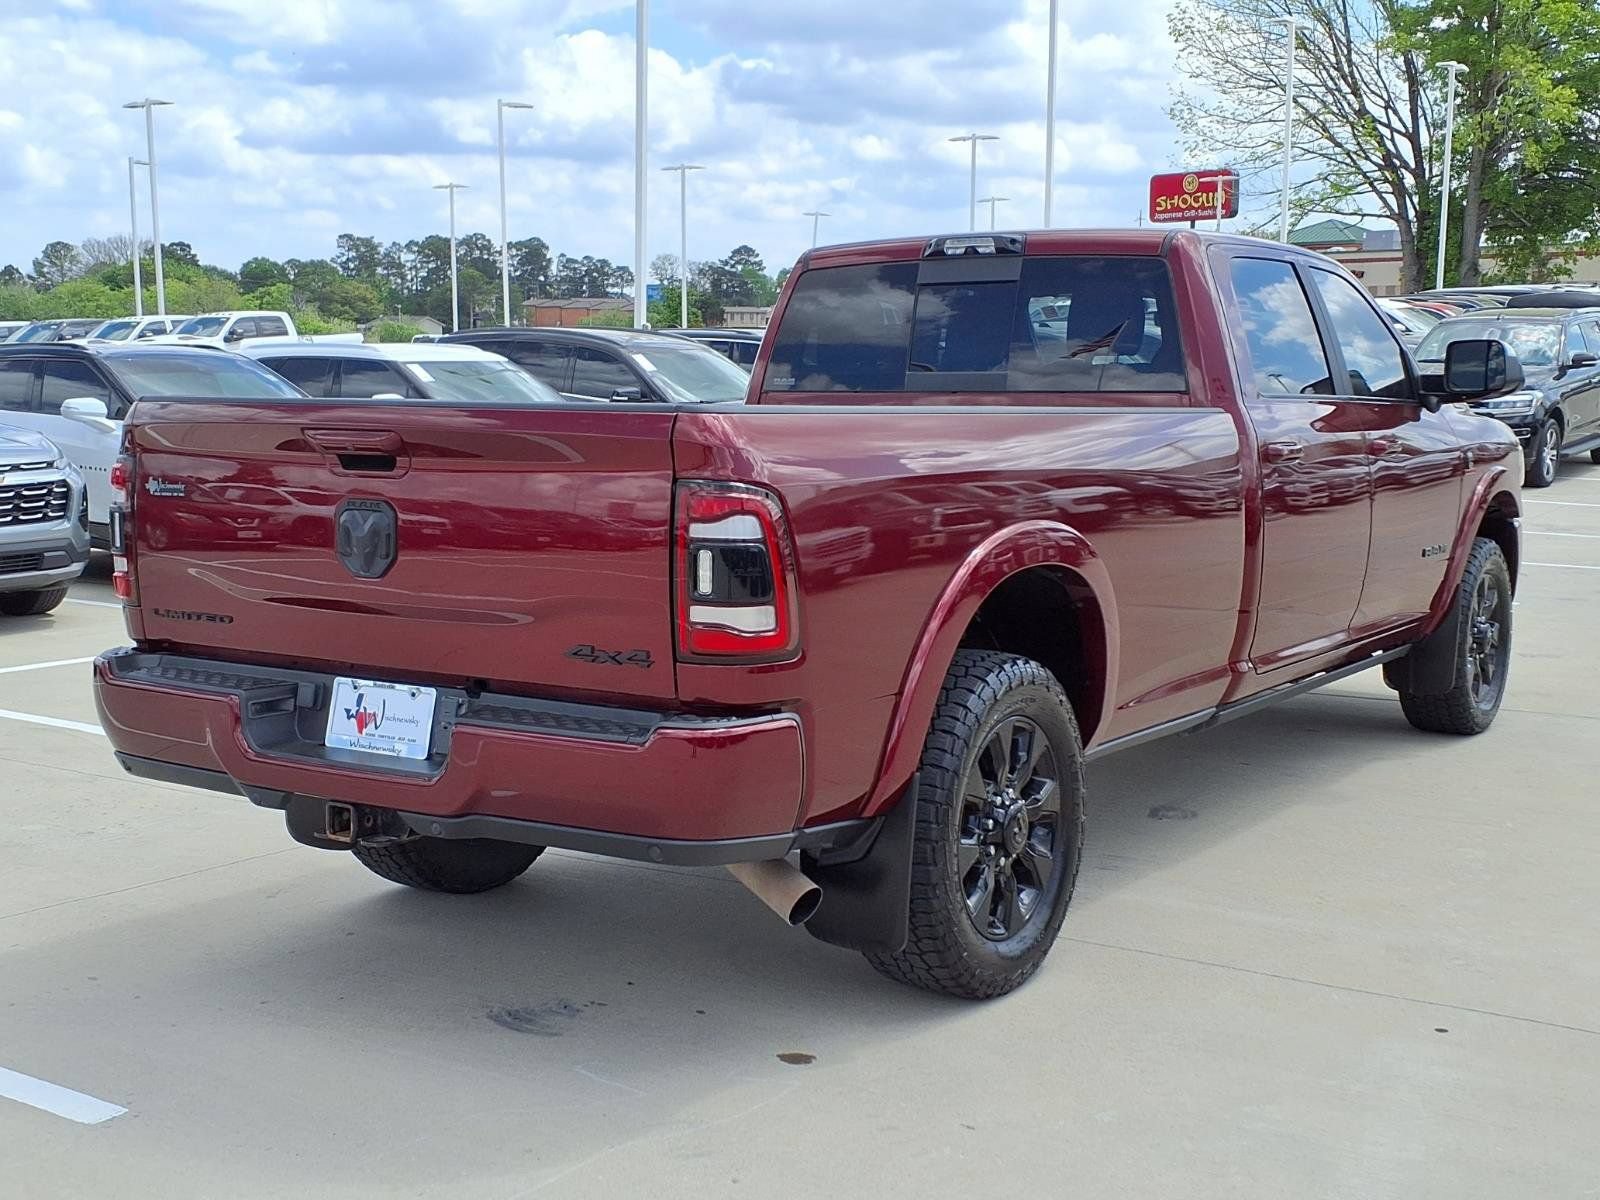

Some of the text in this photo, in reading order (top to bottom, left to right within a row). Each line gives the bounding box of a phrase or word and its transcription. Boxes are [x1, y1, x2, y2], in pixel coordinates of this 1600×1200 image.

[1154, 212, 1183, 221] Japanese
[346, 500, 385, 509] RAM
[152, 607, 235, 625] LIMITED
[349, 737, 402, 755] Wischnewsky
